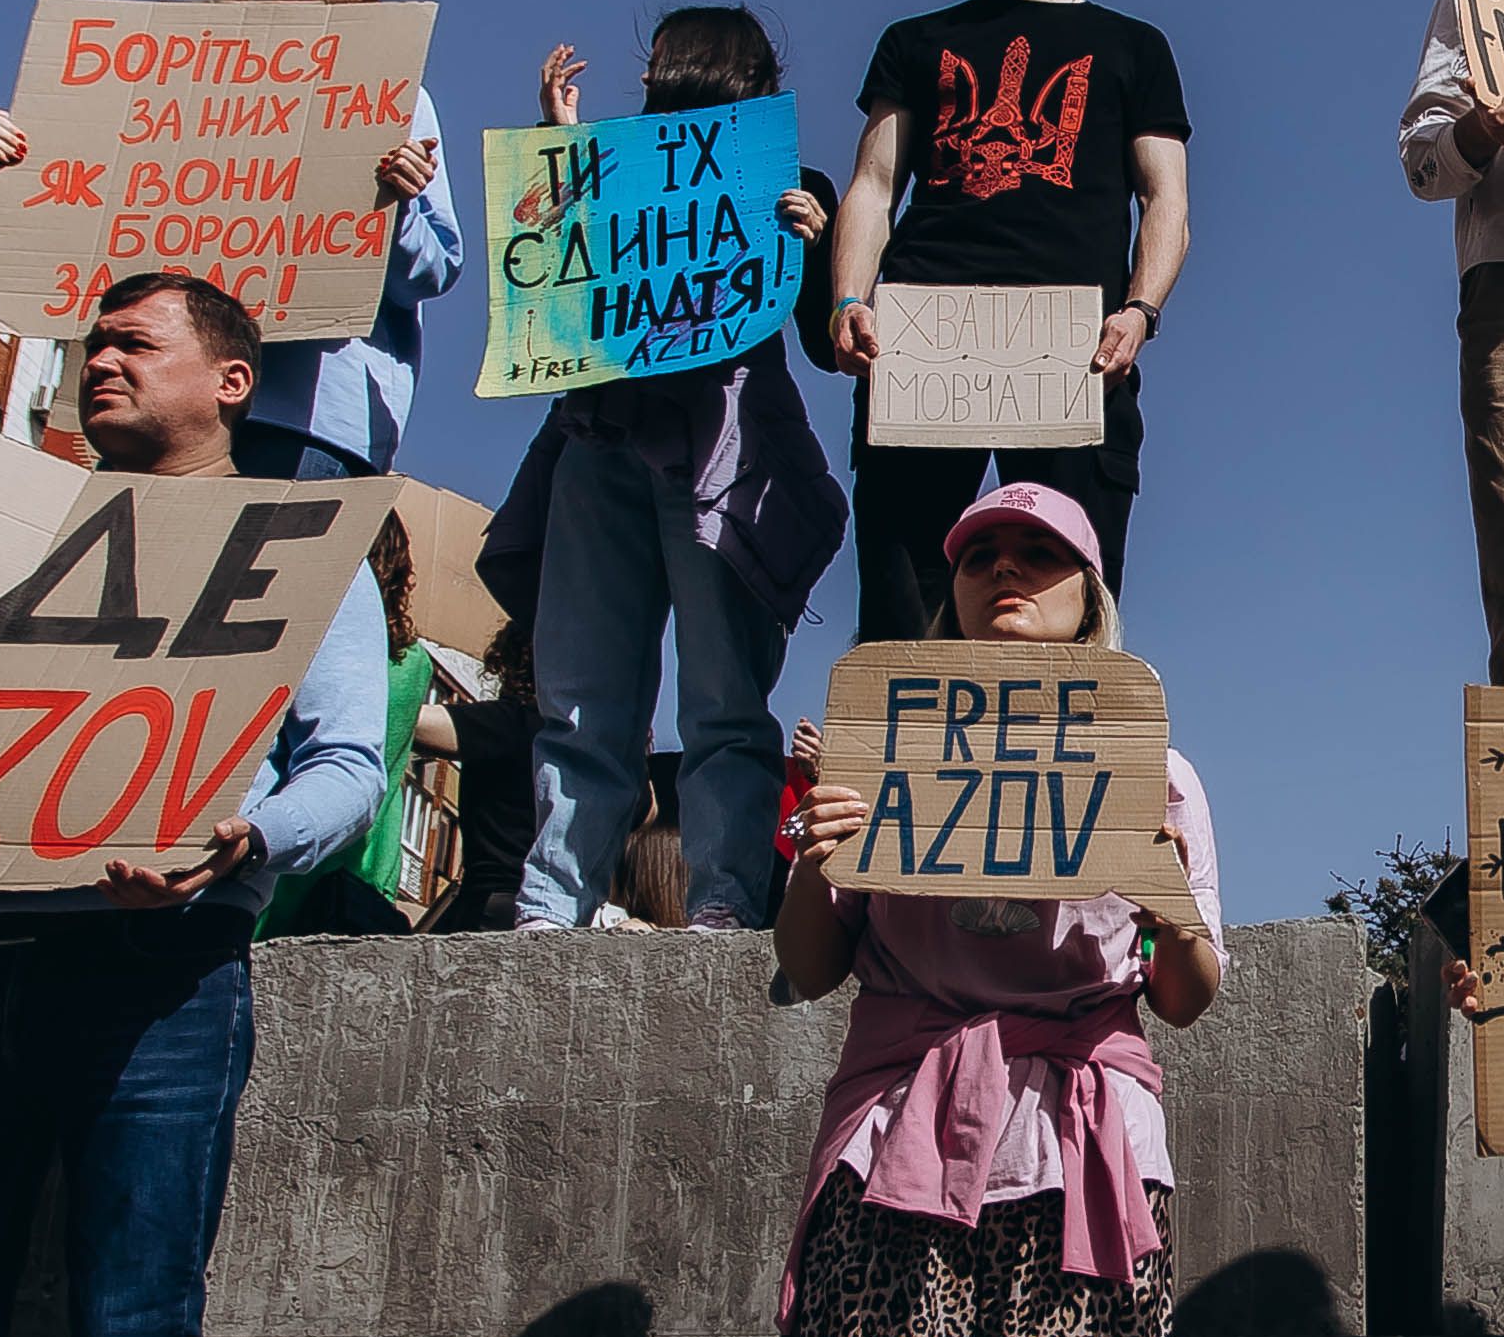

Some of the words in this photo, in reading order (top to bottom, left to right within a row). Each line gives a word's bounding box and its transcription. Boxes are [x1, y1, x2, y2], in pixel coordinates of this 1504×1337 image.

[118, 98, 183, 145] ЗА
[197, 94, 301, 139] НИХ
[315, 78, 413, 131] ТАК,
[22, 160, 107, 208] ЯК
[124, 157, 302, 208] ВОНИ
[537, 136, 601, 208] ТИ
[656, 120, 723, 193] ЇХ
[107, 210, 388, 259] БОРОЛИСЯ
[502, 193, 751, 289] ЄДИНА
[162, 261, 298, 322] С!
[887, 290, 1093, 351] ХВАТИТЬ
[503, 355, 593, 384] #FREE
[624, 317, 749, 372] AZOV
[885, 370, 1091, 424] МОВЧАТИ
[883, 677, 1100, 764] FREE
[856, 769, 1113, 878] AZOV
